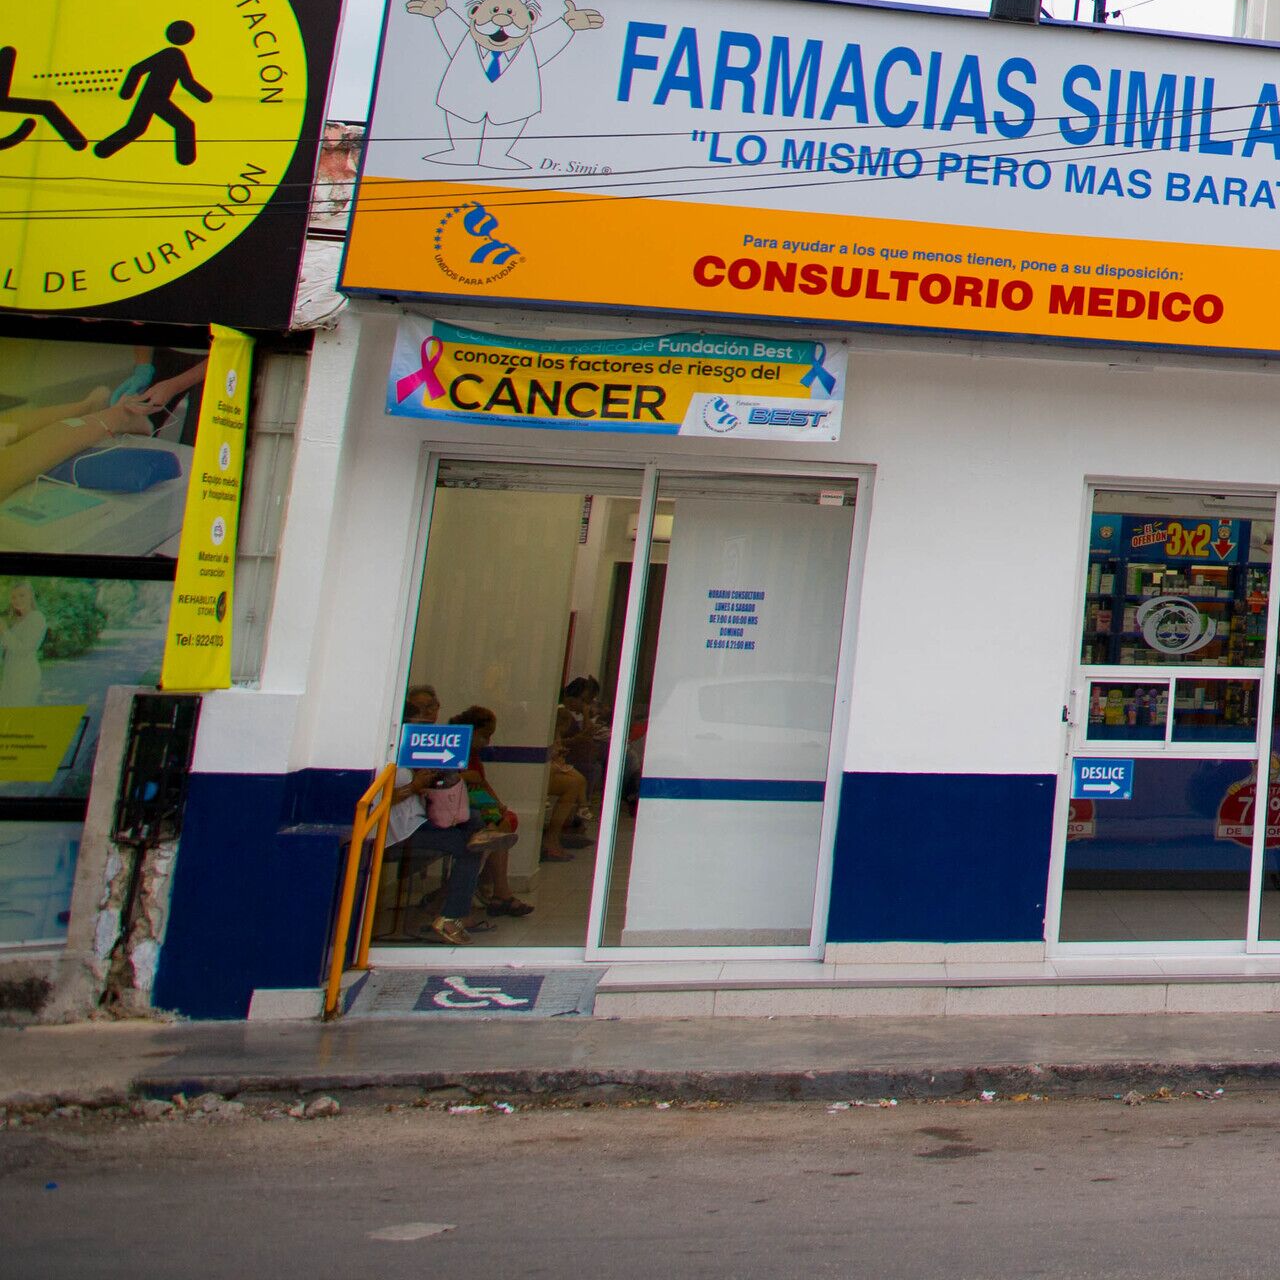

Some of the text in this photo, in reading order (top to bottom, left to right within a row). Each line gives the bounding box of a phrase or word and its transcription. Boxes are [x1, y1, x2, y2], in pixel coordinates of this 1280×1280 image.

[616, 20, 1037, 140] FARMACIAS
[540, 157, 598, 175] Dr. Simi
[691, 129, 767, 166] "LO
[780, 138, 924, 179] MISMO
[937, 151, 1052, 190] PERO
[1064, 163, 1152, 200] MAS
[43, 270, 87, 293] DE
[110, 163, 267, 282] CURACIÓN
[434, 253, 518, 285] UNIDOS PARA AYUDAR
[743, 234, 1185, 282] Para ayudar a los que menos tienen, pone a su disposición:
[693, 254, 1225, 326] CONSULTORIO MEDICO
[658, 338, 749, 356] Fundación
[752, 344, 793, 359] Best
[453, 349, 781, 383] conozca los factores de riesgo del
[449, 367, 667, 421] CÁNCER
[748, 408, 829, 428] BEST
[1164, 521, 1213, 558] 3x2
[410, 733, 462, 747] DESLICE
[1081, 766, 1125, 780] DESLICE
[1226, 827, 1242, 836] DE
